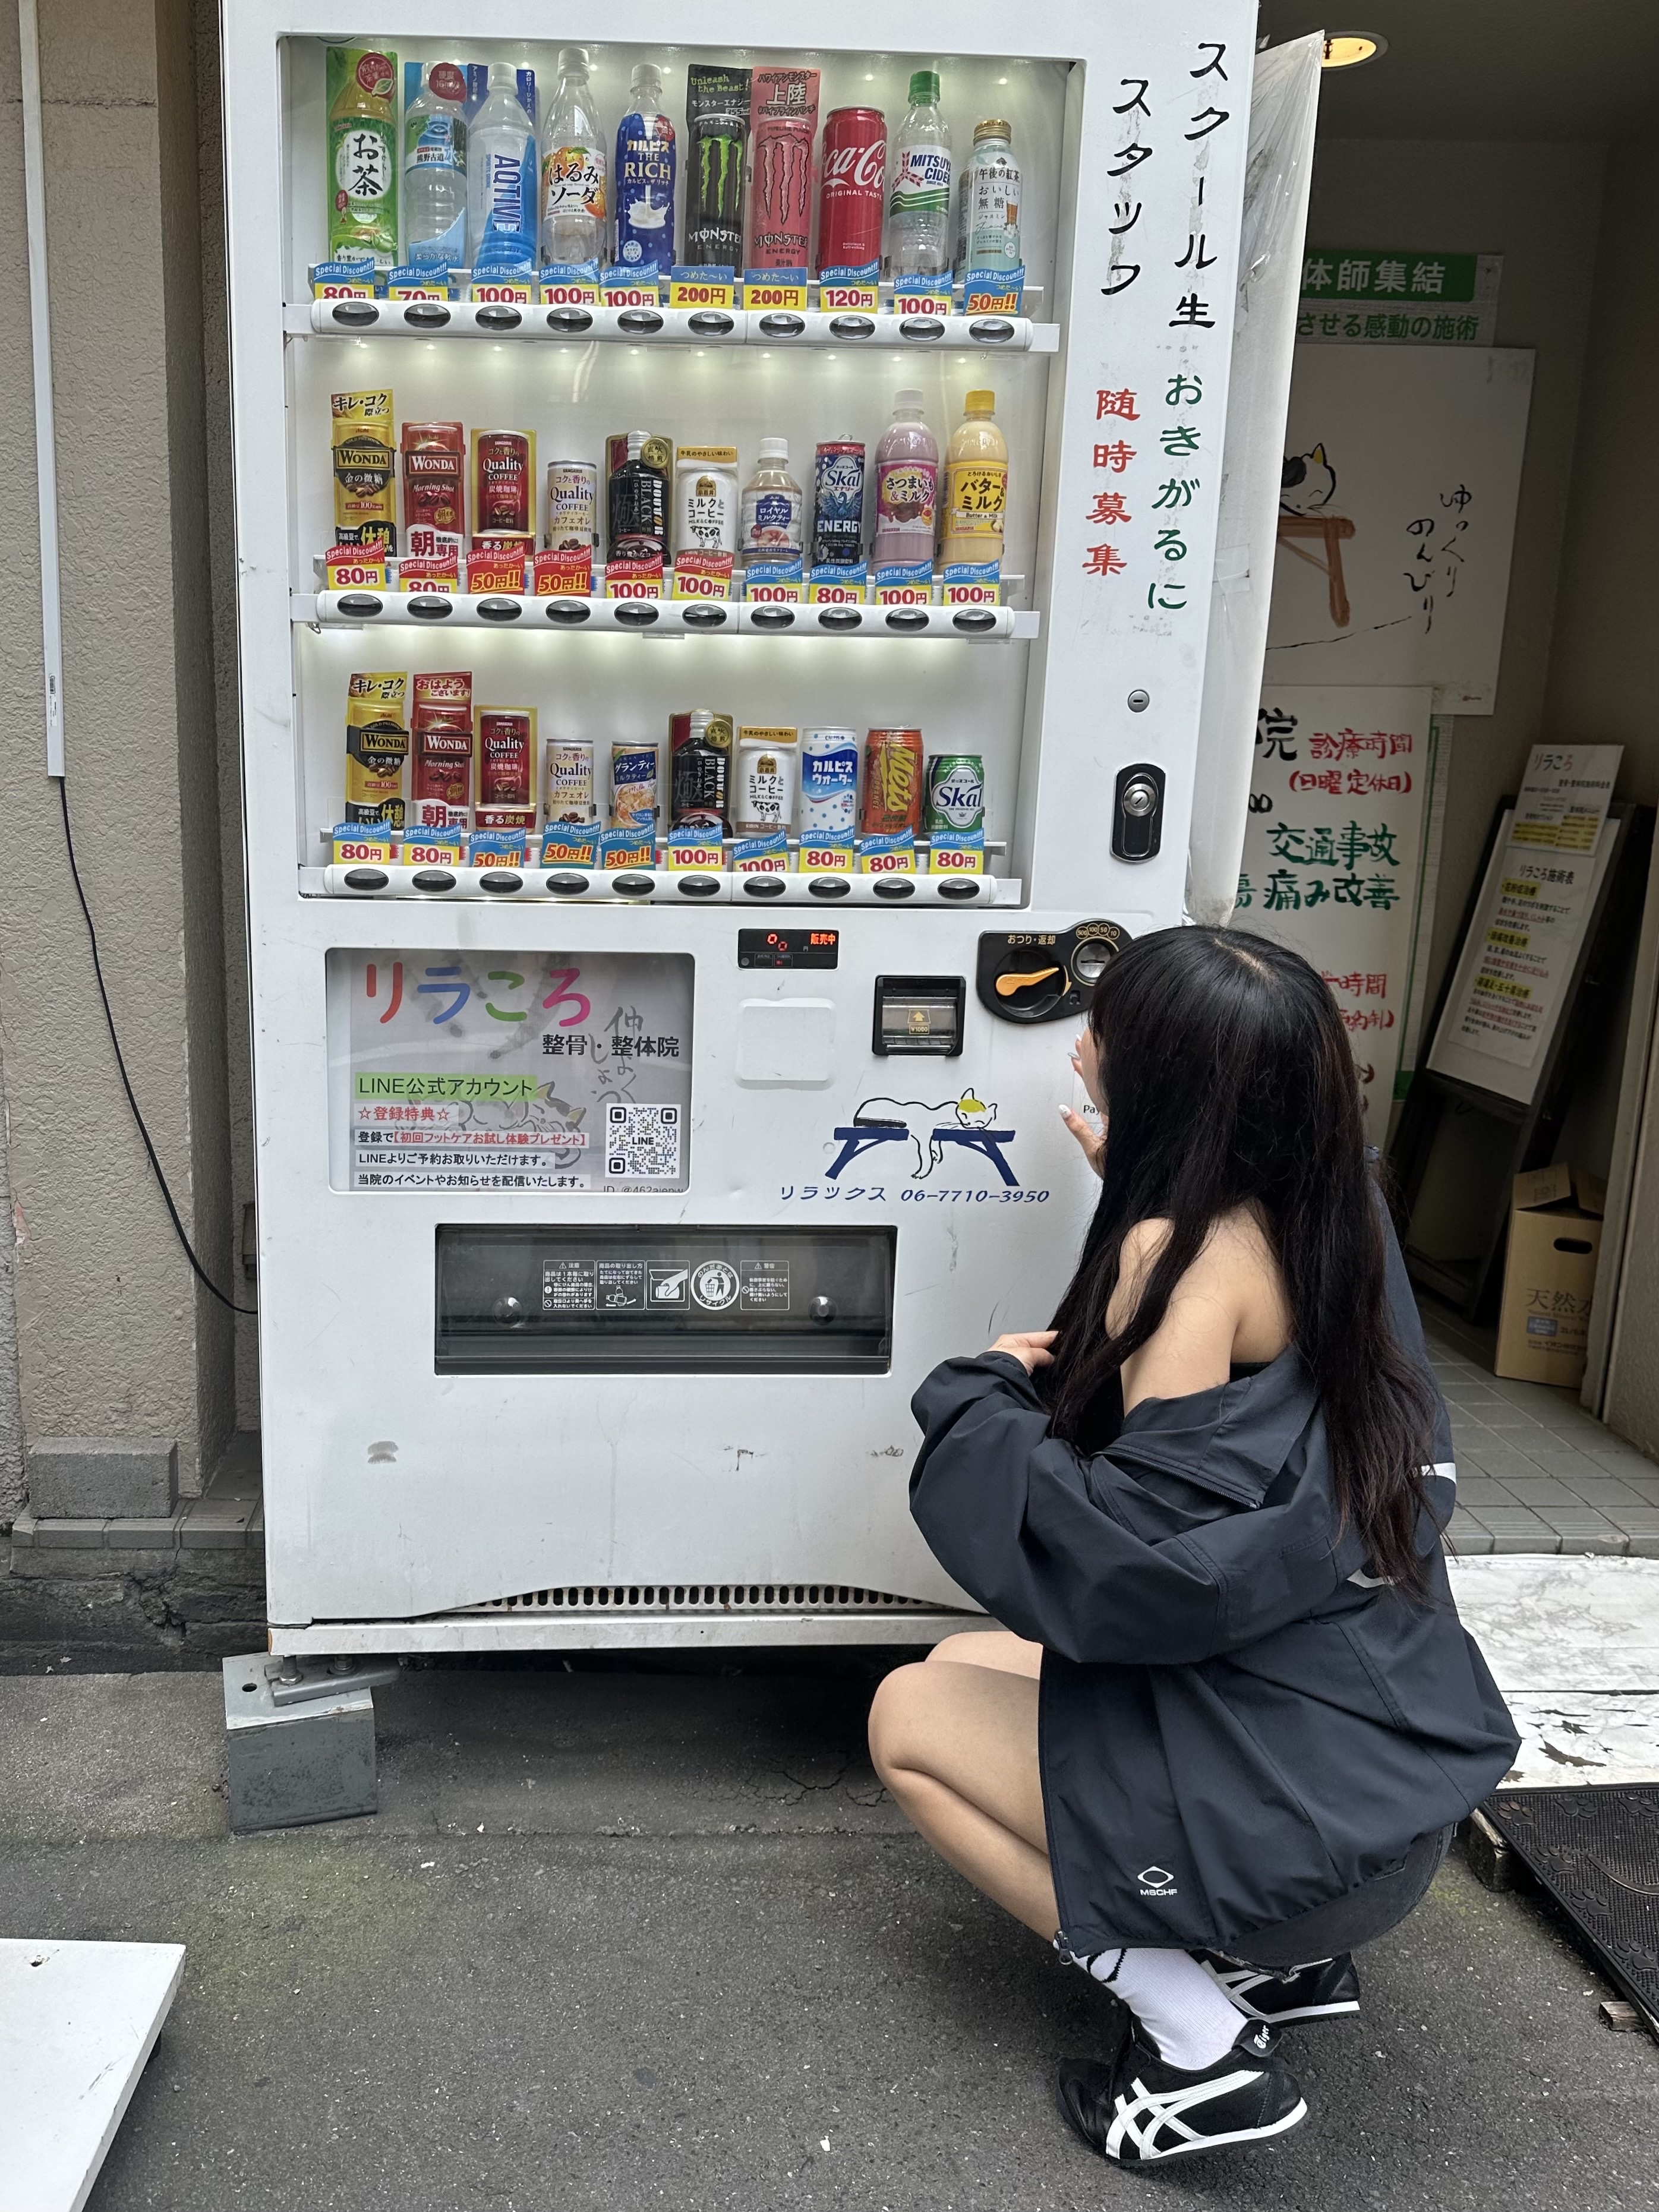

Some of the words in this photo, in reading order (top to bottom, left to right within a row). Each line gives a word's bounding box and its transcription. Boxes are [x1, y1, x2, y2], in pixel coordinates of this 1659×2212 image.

[690, 74, 730, 86] Unleash
[758, 72, 817, 83] ハワイアンモンスター
[698, 84, 715, 93] the
[766, 83, 807, 106] 上陸
[691, 99, 750, 108] モンスターエナジー
[627, 140, 670, 152] カルピス
[348, 133, 383, 196] お茶
[638, 153, 660, 162] THE
[548, 162, 600, 185] はるみ
[625, 162, 671, 180] RICH
[979, 168, 1020, 184] 午後の紅茶
[492, 153, 523, 234] AQTIVE
[979, 185, 1020, 196] おいしい
[1101, 78, 1153, 295] スタッフ
[1169, 43, 1229, 328] スクール生
[551, 187, 600, 205] ソーダ
[826, 190, 863, 200] ORIGINAL
[978, 197, 1004, 210] 無糖
[316, 264, 341, 276] Special
[966, 269, 992, 282] Special
[323, 286, 366, 299] 80円
[477, 287, 527, 304] 100円
[545, 287, 594, 304] 100円
[604, 290, 654, 307] 100円
[677, 287, 726, 304] 200円
[751, 290, 799, 306] 200円
[826, 289, 873, 307] 120円
[898, 298, 947, 315] 100円
[967, 294, 1018, 311] 50円!!
[1297, 312, 1479, 340] させる感動の施術
[333, 393, 387, 411] キレ・コク
[364, 407, 390, 416] 際立つ
[340, 450, 385, 465] WONDA
[488, 447, 519, 456] コクと香りの
[411, 455, 455, 471] WONDA
[482, 456, 523, 475] Quality
[345, 473, 383, 485] 金の微糖
[556, 475, 591, 485] コクと香りの
[886, 475, 934, 492] さつまいも
[960, 478, 1001, 494] バター
[1081, 388, 1141, 576] 随時募集
[413, 482, 440, 493] Morning
[488, 485, 518, 494] 炭焼珈琲
[550, 485, 594, 506] Quality
[1147, 374, 1203, 610] おきがるに
[641, 480, 652, 523] BLACK
[687, 498, 724, 509] ミルクと
[890, 491, 930, 502] &ミルク
[961, 496, 1003, 512] ミルク
[556, 503, 589, 512] COFFEE
[688, 509, 724, 518] コーヒー
[554, 516, 591, 526] カフェオレ
[411, 531, 435, 557] 朝
[1439, 484, 1472, 597] ゆっくり
[400, 559, 425, 571] Special
[336, 567, 378, 585] 80円
[1402, 517, 1436, 635] のんびり
[408, 581, 450, 592] 80円
[610, 583, 659, 598] 100円
[677, 576, 725, 598] 100円
[750, 587, 798, 602] 100円
[816, 588, 857, 603] 80円
[880, 589, 928, 605] 100円
[948, 587, 995, 603] 100円
[354, 678, 405, 693] キレ・コク
[417, 679, 464, 689] おはよう
[364, 733, 406, 749] WONDA
[427, 735, 468, 750] WONDA
[484, 736, 525, 753] Quality
[1308, 728, 1413, 761] 診療時間
[368, 755, 401, 765] 金の微糖
[556, 753, 589, 761] コクと香りの
[550, 762, 593, 780] Quality
[614, 760, 655, 774] グランティー
[812, 761, 853, 773] カルピス
[704, 758, 715, 799] BLACK
[749, 775, 784, 785] ミルクと
[812, 774, 853, 785] ウォーター
[554, 791, 589, 799] カフェオレ
[749, 785, 784, 794] コーヒー
[422, 804, 446, 828] 朝
[484, 815, 526, 825] 香る炭焼
[800, 832, 824, 842] Special
[341, 844, 382, 861] 80円
[1266, 820, 1401, 871] 交通事故
[411, 847, 452, 864] 80円
[673, 849, 718, 864] 100円
[807, 851, 846, 867] 80円
[869, 855, 909, 872] 80円
[937, 851, 976, 868] 80円
[739, 858, 786, 872] 100円
[1263, 869, 1401, 911] 痛み改善
[810, 932, 836, 945] 販売中
[1007, 935, 1056, 945] おつり・返却
[365, 961, 591, 1027] リラころ
[542, 1034, 680, 1058] 整骨・整体院
[359, 1077, 533, 1097] LINE公式アカウント
[632, 1137, 655, 1146] LINE
[359, 1153, 548, 1167] LINEよりご予約お取りいただけます。
[358, 1174, 585, 1189] 当院のイベントやお知らせを配信いたします。
[781, 1185, 888, 1202] リラックス
[900, 1188, 1050, 1203] 06-7710-3950
[697, 1264, 734, 1279] のんだあとは
[699, 1295, 732, 1307] リサイクル
[1140, 1888, 1178, 1897] MSCHF
[1253, 2024, 1270, 2049] Tiger
